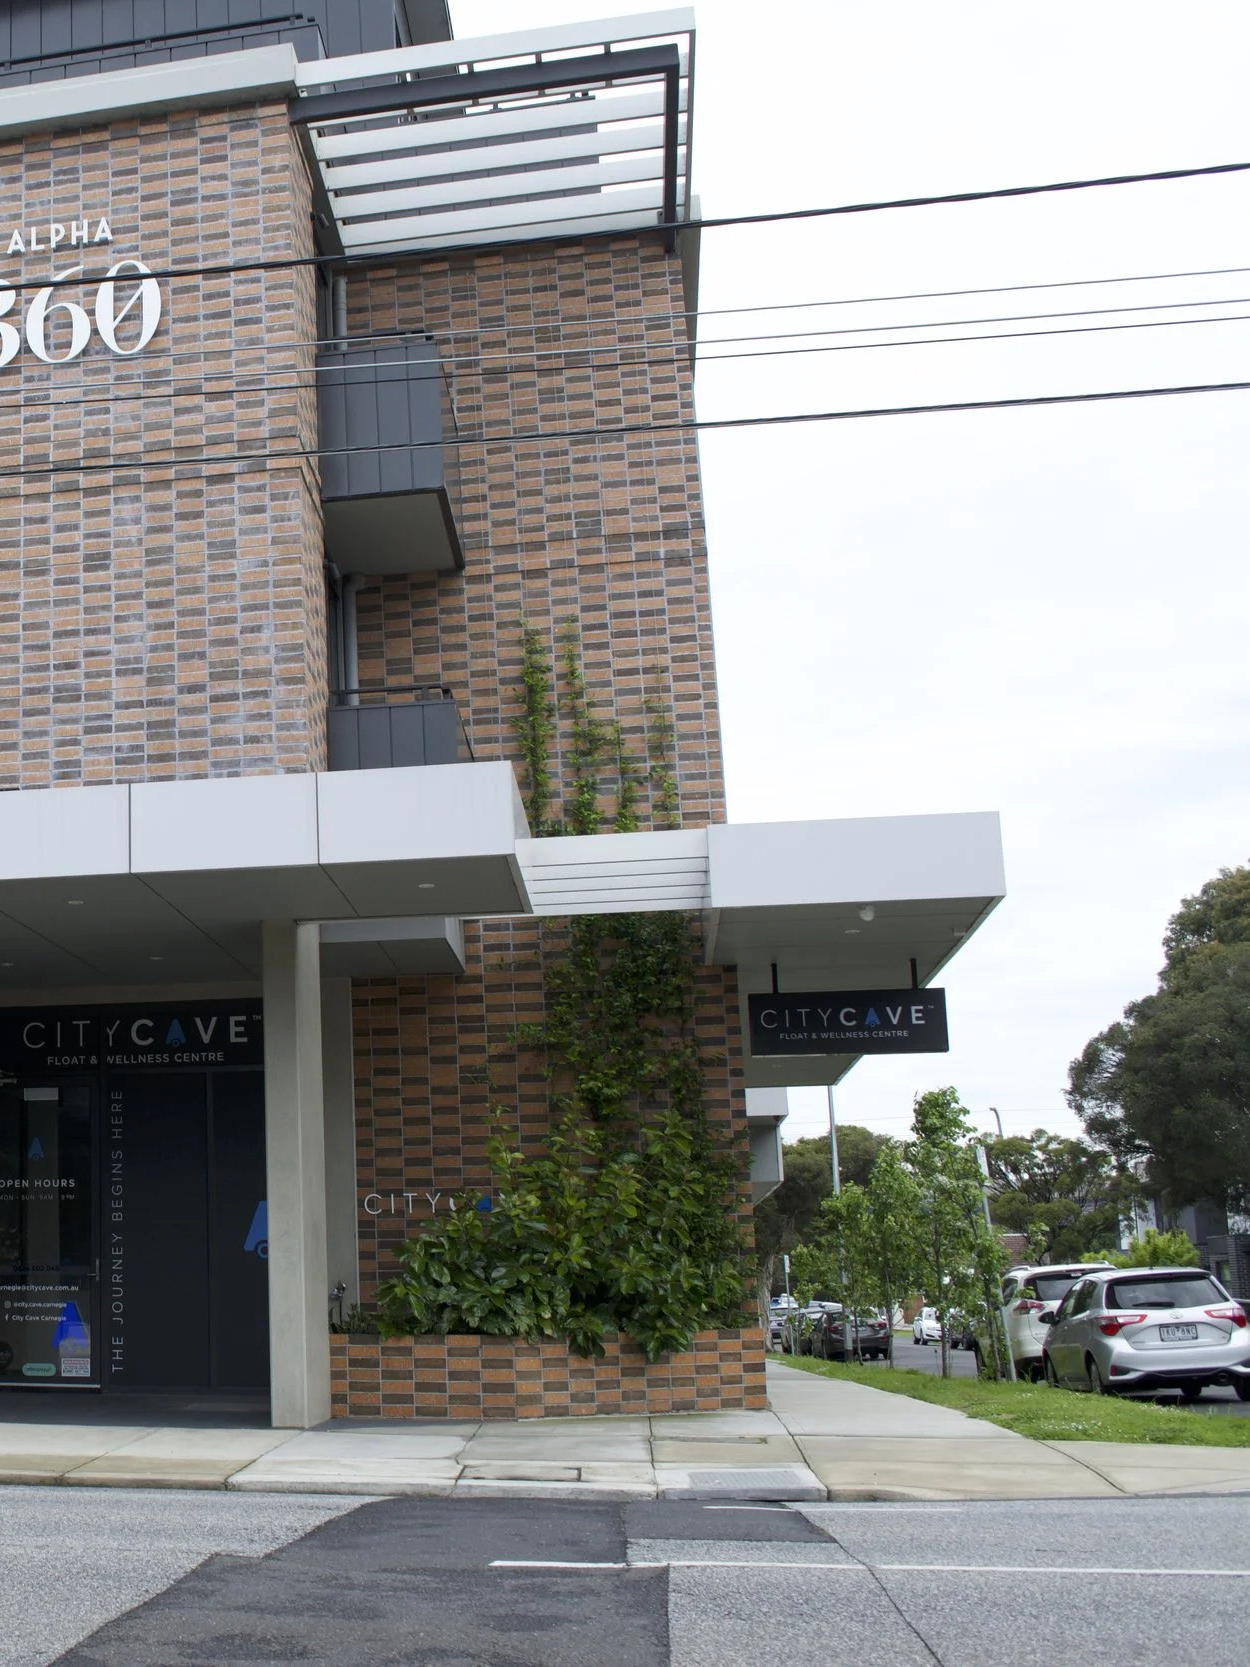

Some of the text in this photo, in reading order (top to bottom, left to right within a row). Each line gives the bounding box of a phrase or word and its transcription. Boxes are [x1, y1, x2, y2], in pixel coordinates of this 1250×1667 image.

[7, 217, 113, 254] ALPHA
[780, 1032, 808, 1040] FLOAT
[820, 1031, 869, 1039] WELLNESS
[872, 1030, 909, 1038] CENTRE
[47, 1055, 86, 1065] FLOAT
[90, 1055, 98, 1065] &
[174, 1052, 224, 1063] CENTRE
[34, 1178, 75, 1188] HOURS
[111, 1090, 124, 1373] THE JOURNEY BEGINS HERE
[41, 1314, 67, 1322] Carnegie
